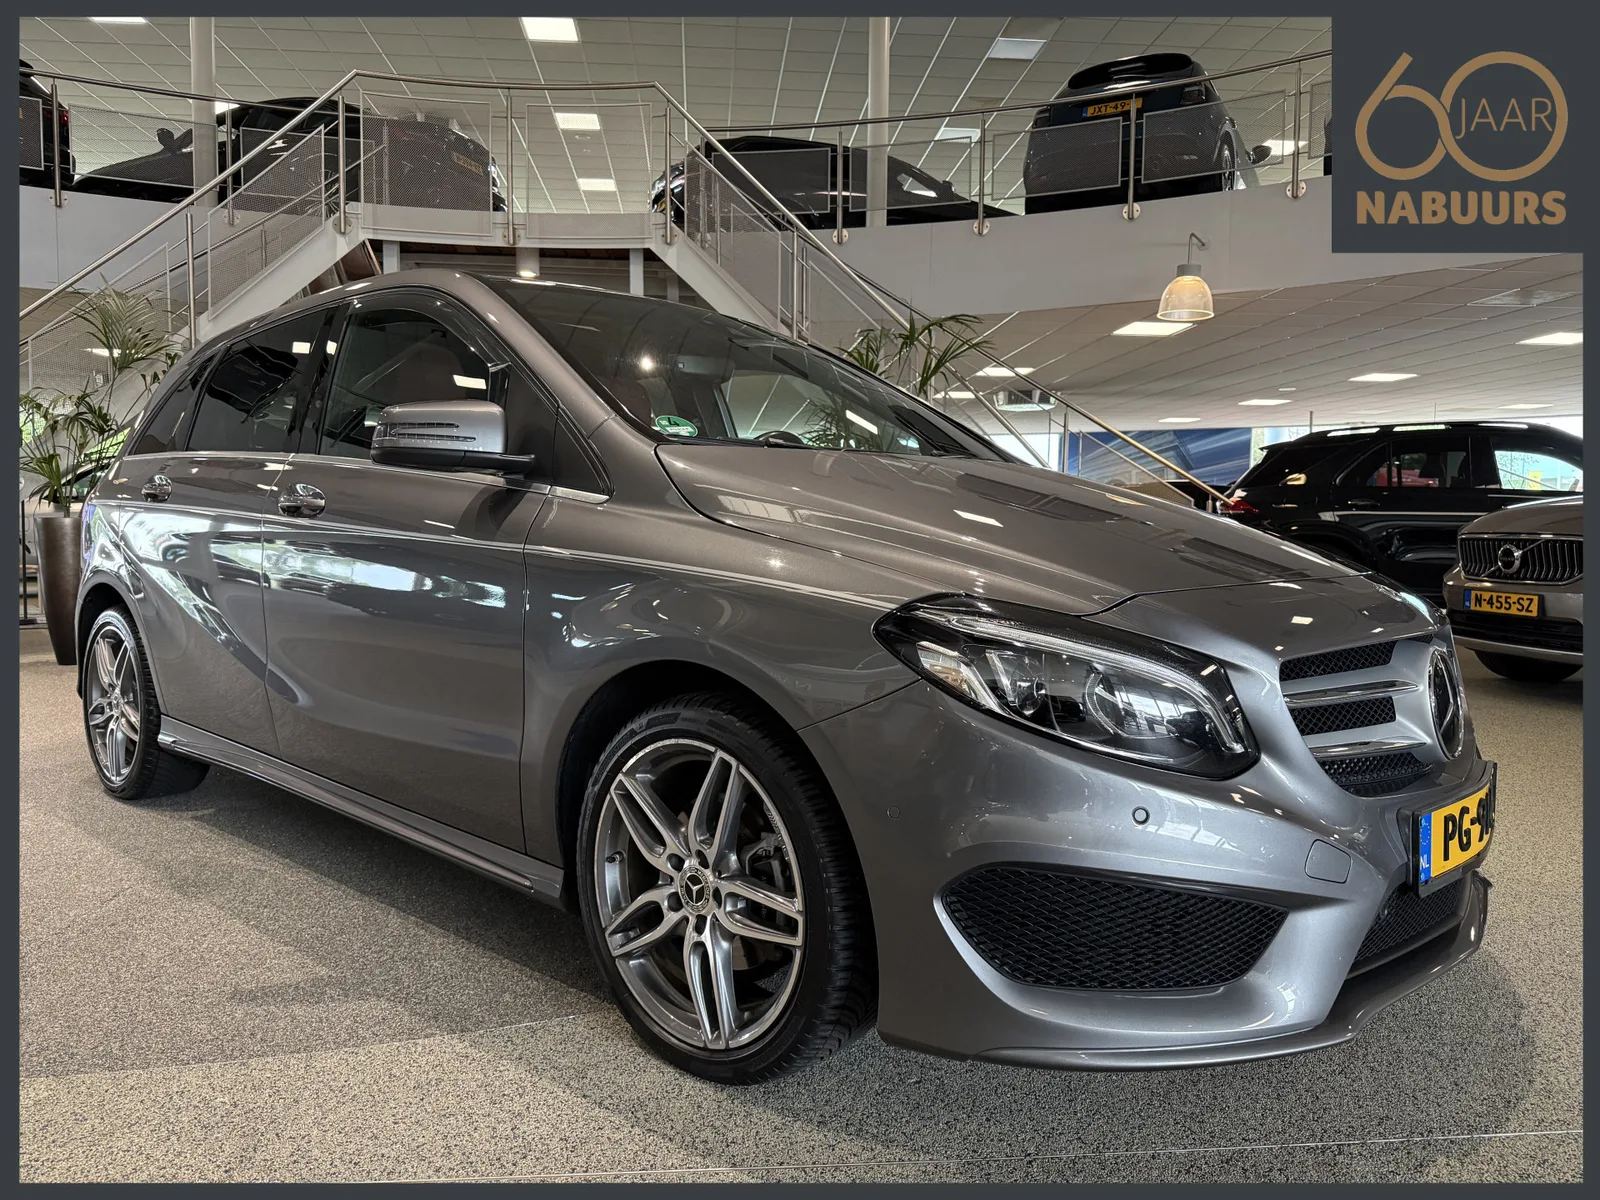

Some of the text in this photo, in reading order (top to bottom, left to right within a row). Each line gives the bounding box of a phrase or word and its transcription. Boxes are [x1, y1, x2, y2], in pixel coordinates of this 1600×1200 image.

[1091, 101, 1132, 115] JXT-49-
[1474, 593, 1534, 613] N-455-SZ
[1420, 854, 1429, 870] NL
